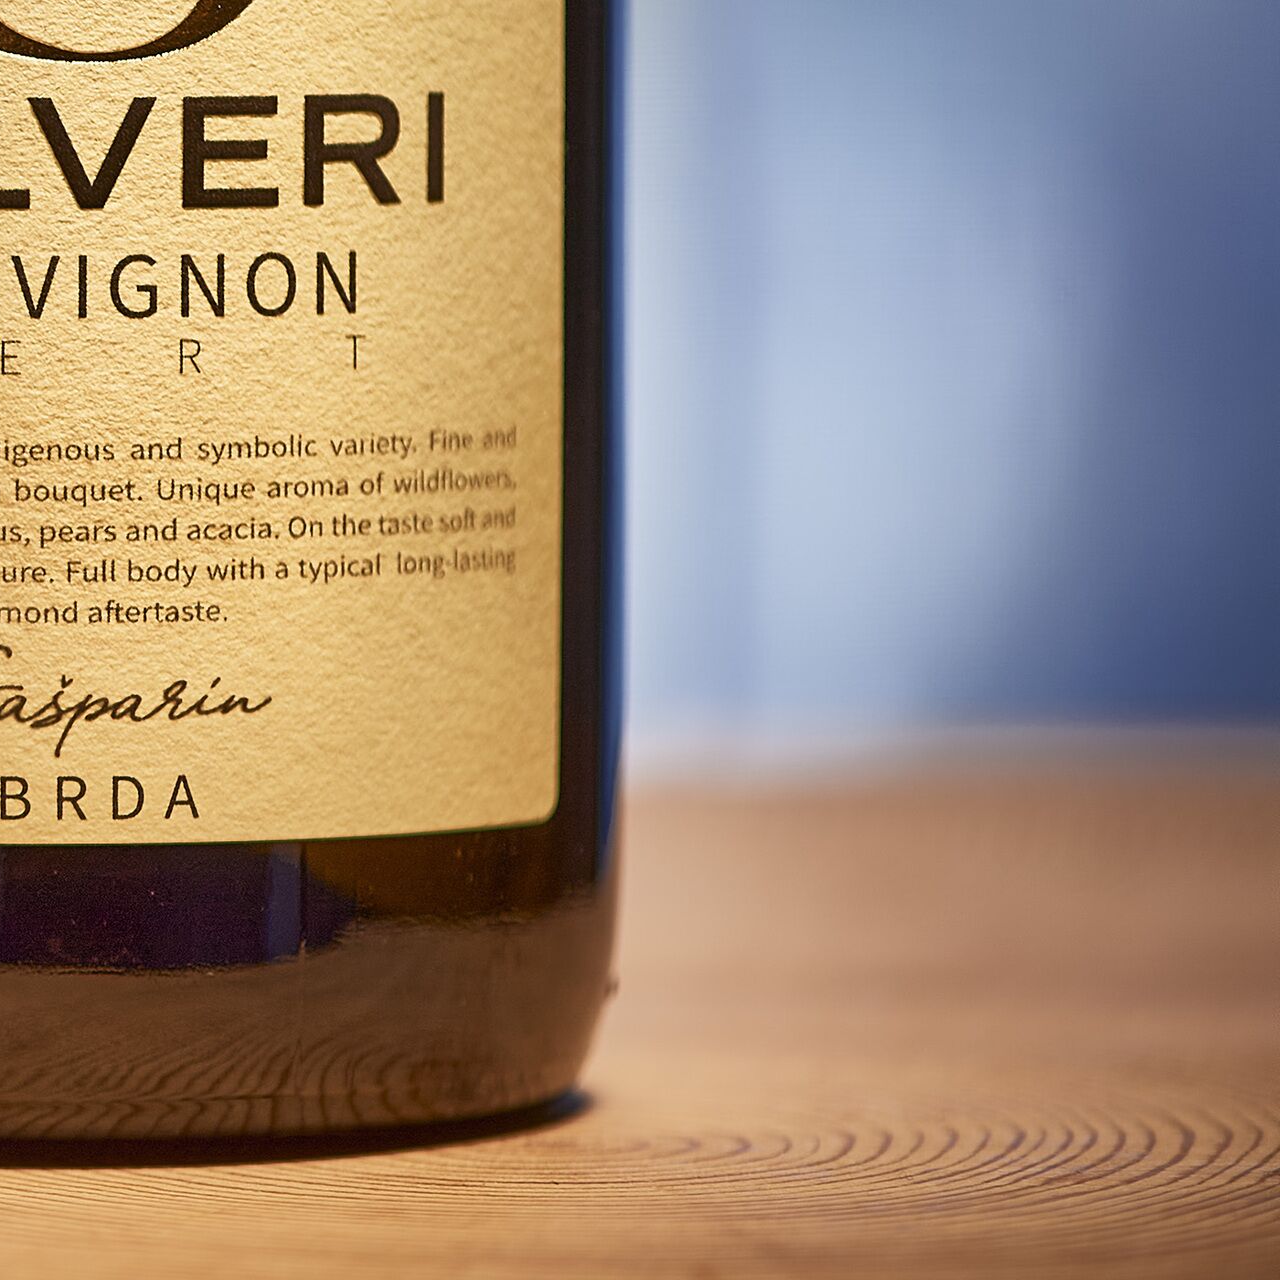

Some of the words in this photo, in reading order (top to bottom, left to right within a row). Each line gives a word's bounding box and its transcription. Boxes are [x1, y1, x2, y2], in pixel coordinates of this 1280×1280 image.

[130, 438, 182, 460] and
[197, 434, 318, 465] symbolic
[330, 434, 417, 460] variety.
[429, 430, 473, 452] Fine
[483, 426, 517, 449] and
[15, 480, 143, 508] bouquet.
[157, 479, 256, 505] Unique
[267, 481, 349, 498] aroma
[360, 472, 384, 494] of
[394, 469, 517, 494] wildflowers,
[40, 524, 117, 548] pears
[126, 518, 178, 542] and
[186, 518, 280, 541] acacia.
[288, 516, 323, 539] On
[332, 514, 371, 536] the
[378, 512, 433, 535] taste
[440, 508, 476, 532] soft
[481, 507, 516, 529] and
[66, 560, 116, 583] Full
[128, 558, 197, 587] body
[207, 556, 265, 582] with
[275, 560, 288, 579] a
[299, 553, 382, 584] typical
[396, 547, 516, 577] long-lasting
[88, 600, 228, 624] aftertaste.
[0, 774, 199, 820] BRDA
